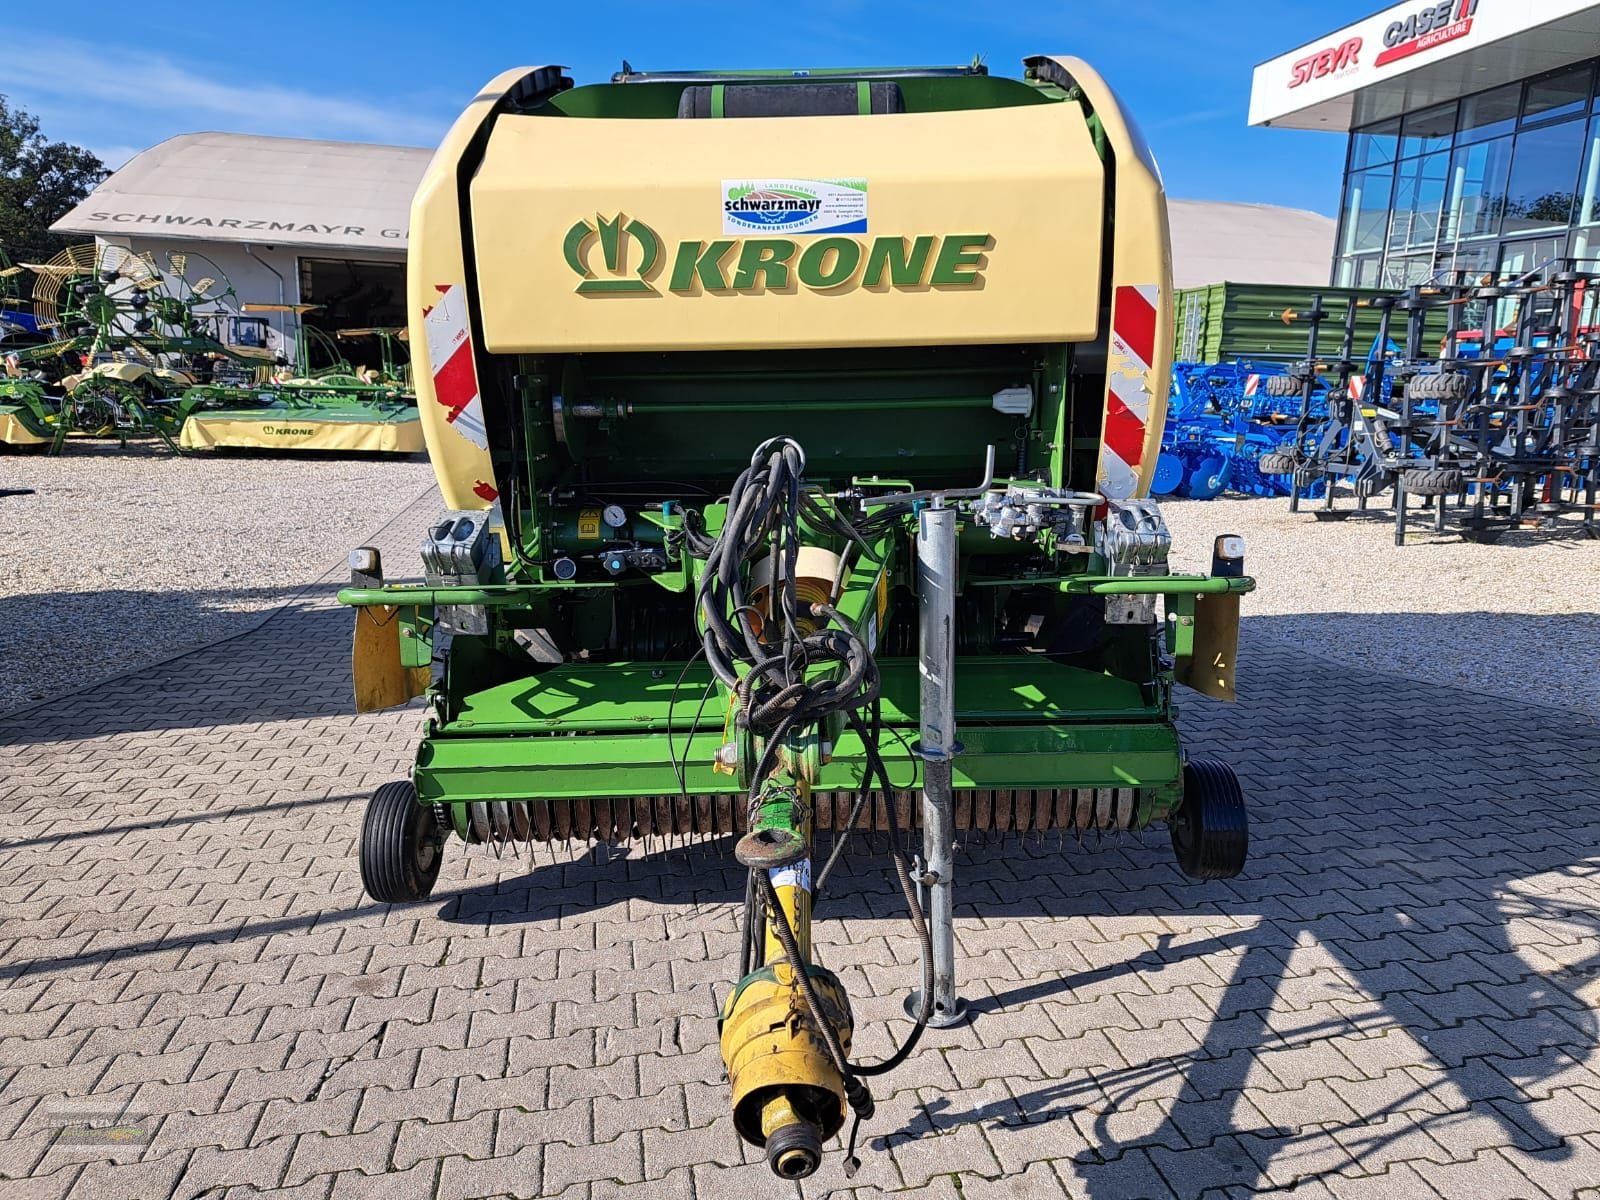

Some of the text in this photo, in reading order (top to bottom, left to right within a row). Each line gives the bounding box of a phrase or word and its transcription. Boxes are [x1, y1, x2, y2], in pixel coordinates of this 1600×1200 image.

[1383, 1, 1453, 48] CASE
[1416, 20, 1468, 49] AGRICULTURE
[1288, 36, 1363, 89] STEYR
[724, 197, 822, 212] schwarzmayr
[88, 212, 409, 239] SCHWARZMAYR G
[668, 232, 995, 298] KRONE
[275, 428, 315, 436] KRONE
